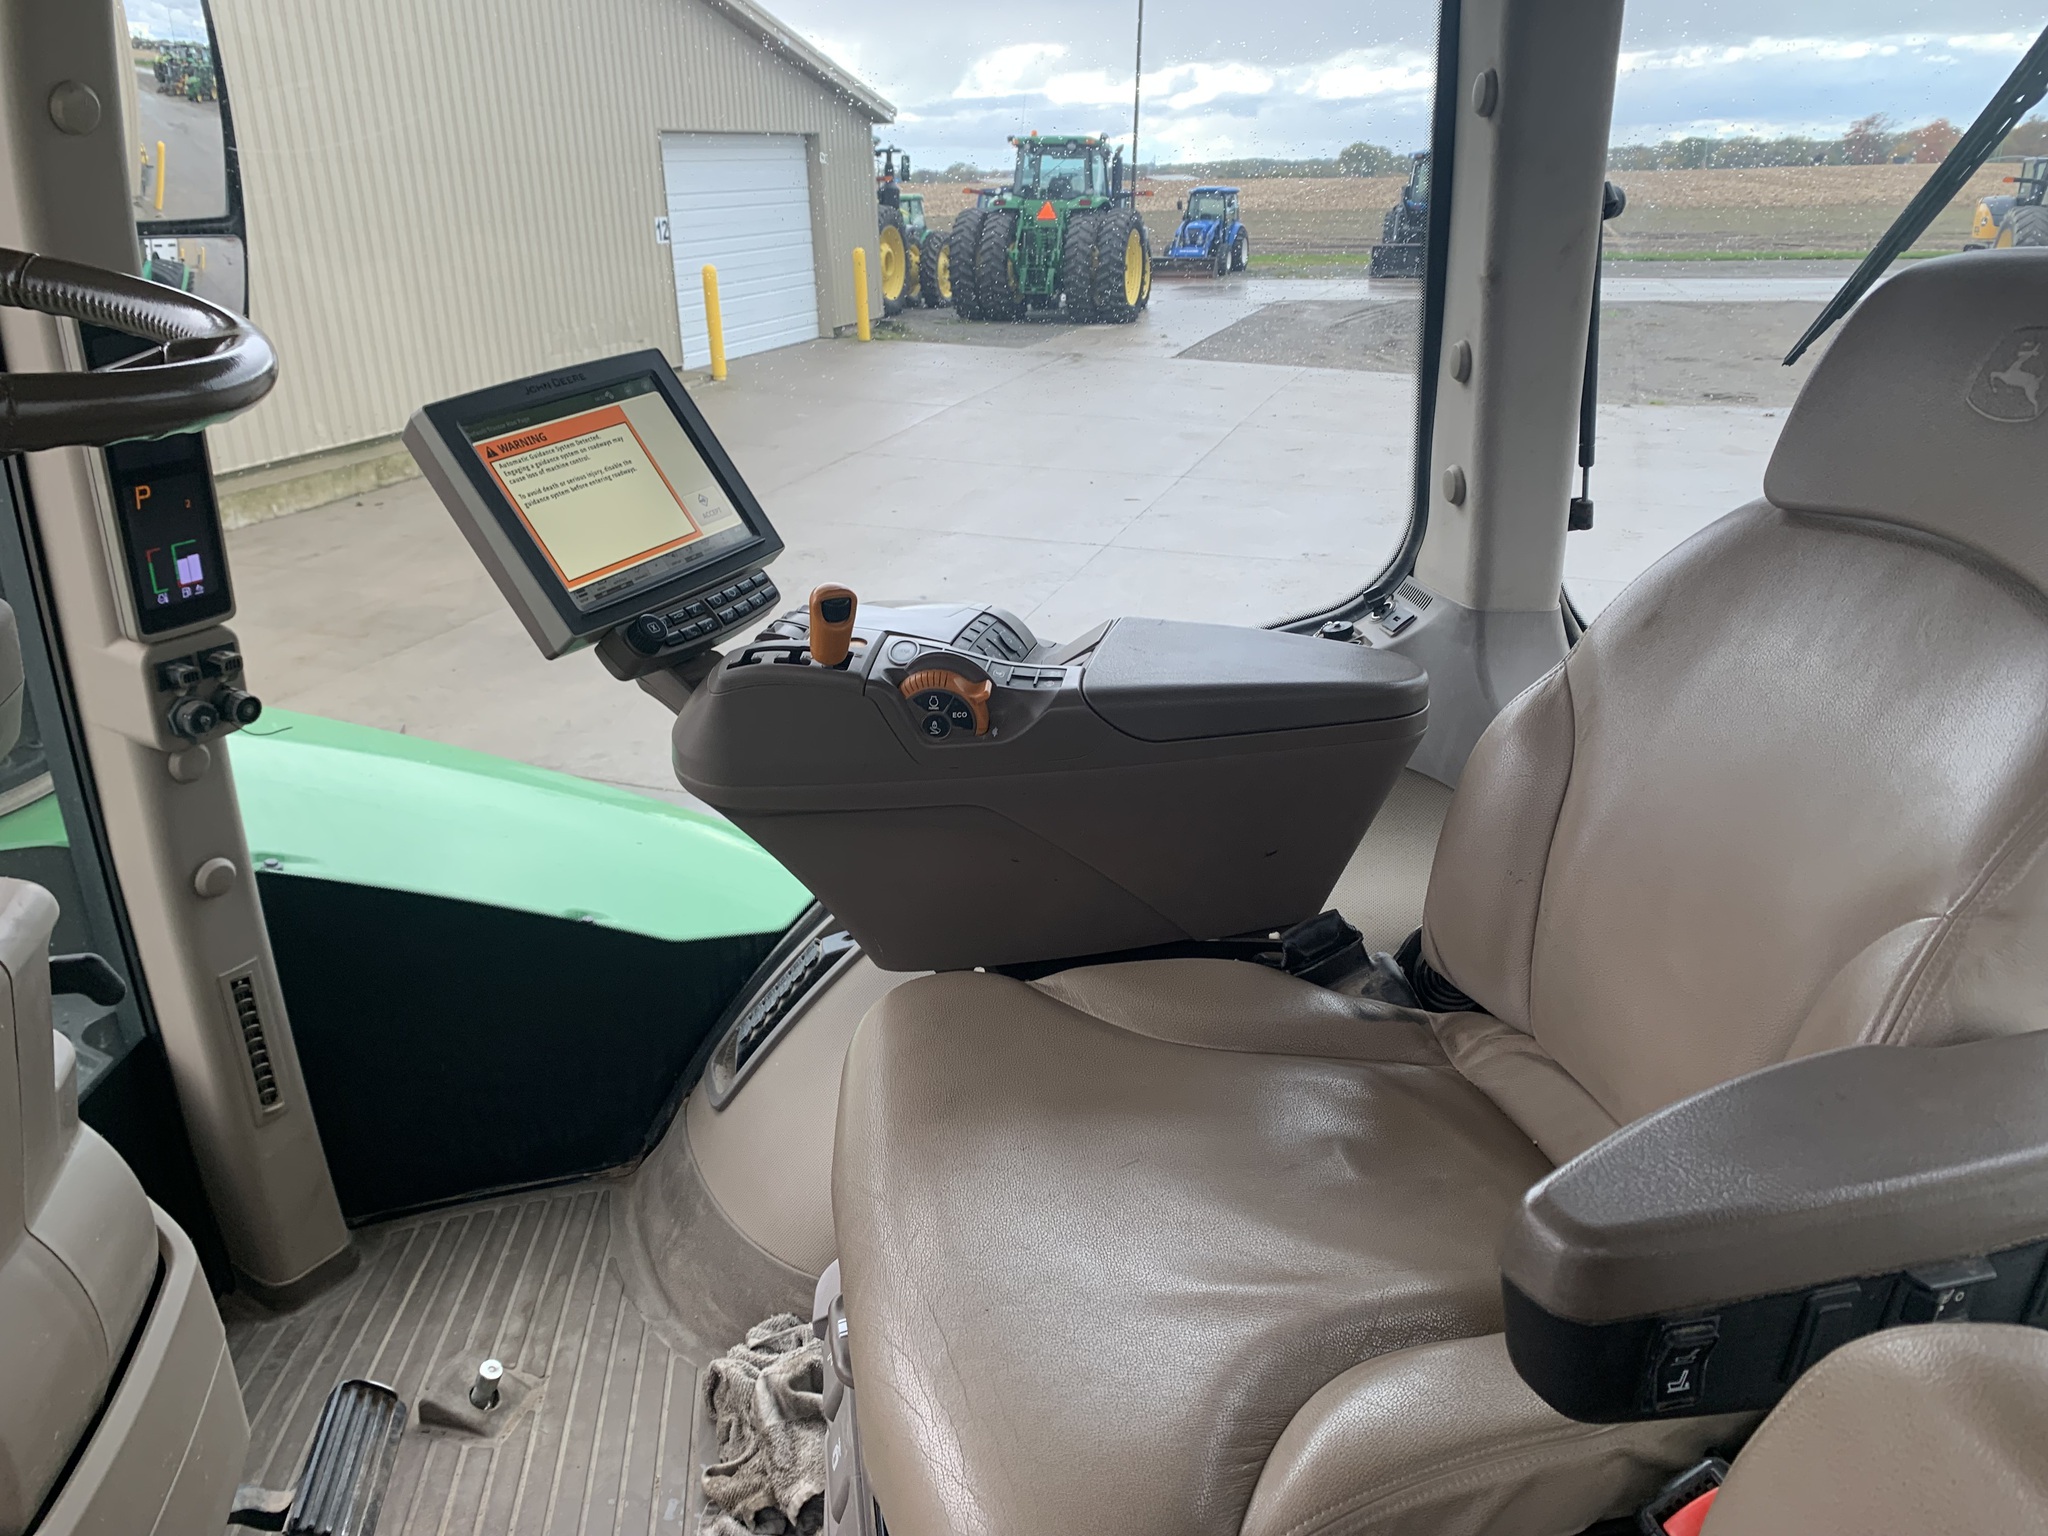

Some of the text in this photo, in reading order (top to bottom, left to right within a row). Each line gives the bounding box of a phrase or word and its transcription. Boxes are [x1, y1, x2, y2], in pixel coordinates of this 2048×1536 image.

[525, 373, 586, 396] JOHN DEERE
[497, 432, 548, 454] WARNING
[499, 434, 601, 470] Automatic Guidance System Detected.
[503, 463, 531, 477] Engaging
[535, 455, 559, 469] guidance
[560, 449, 580, 461] system
[588, 440, 612, 452] roadways
[612, 436, 624, 445] may
[509, 475, 526, 485] cause
[527, 470, 539, 479] loss
[546, 462, 569, 474] machine
[569, 455, 591, 466] control.
[527, 487, 542, 498] avoid
[543, 482, 559, 493] death
[567, 473, 587, 485] serious
[587, 468, 604, 479] injury,
[604, 462, 622, 473] disable
[622, 459, 632, 468] the
[134, 484, 152, 510] P
[524, 467, 638, 509] guidance system before entering roadways.
[702, 507, 722, 519] ACCEPT
[952, 711, 968, 719] ECO
